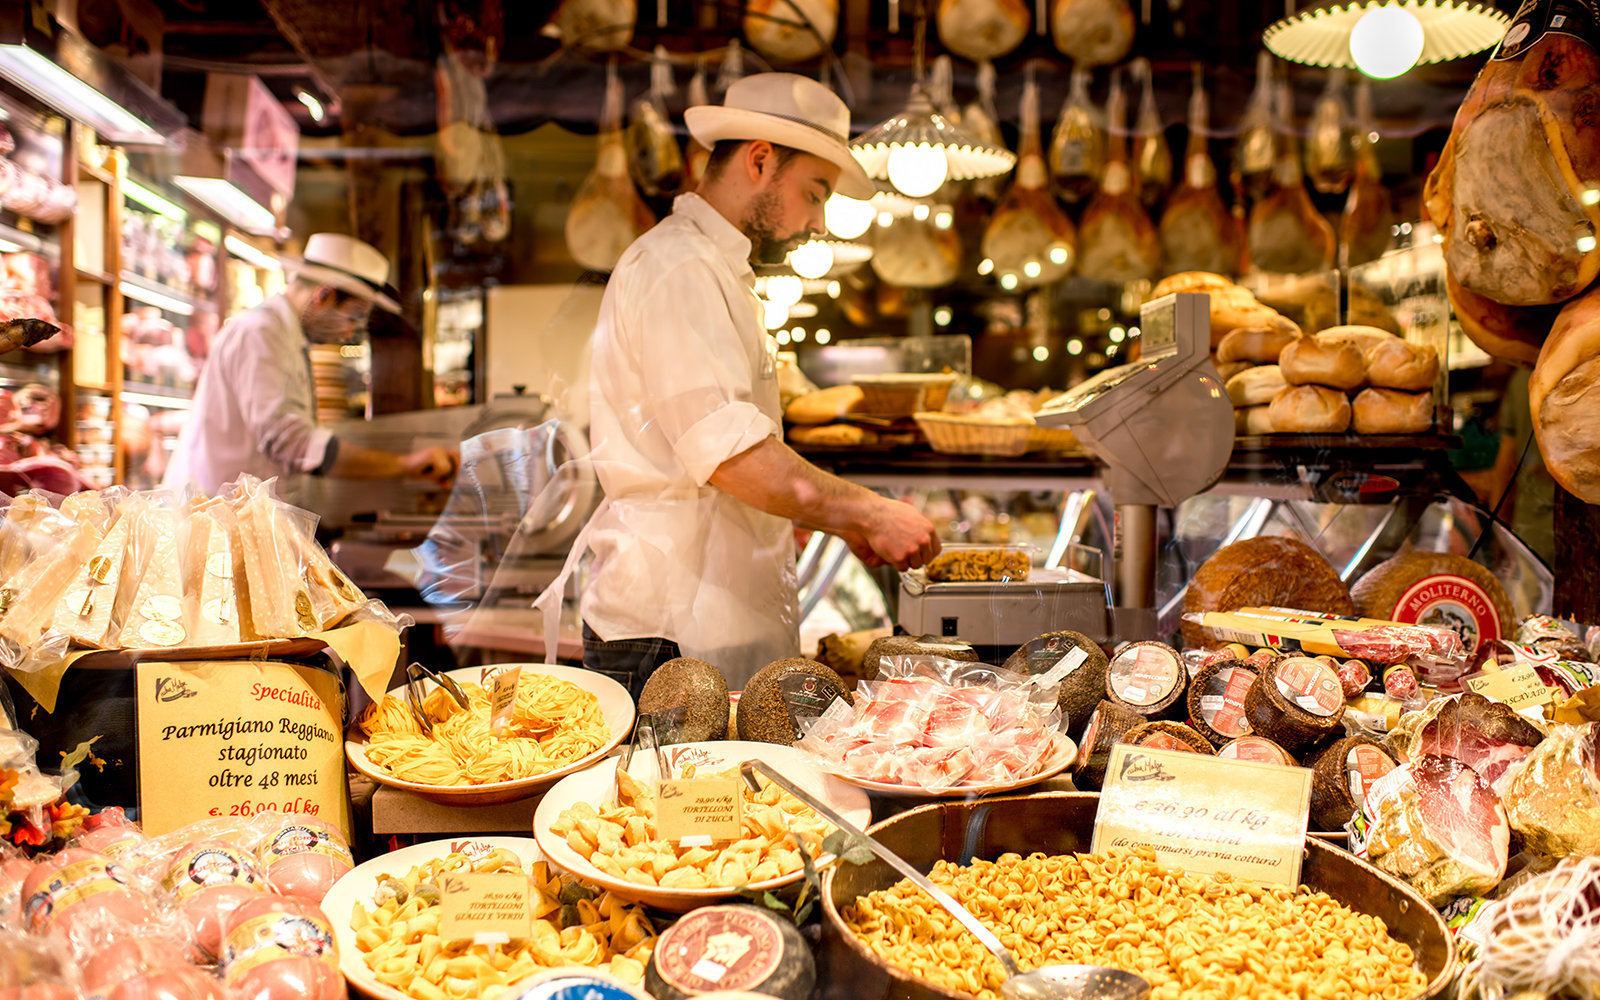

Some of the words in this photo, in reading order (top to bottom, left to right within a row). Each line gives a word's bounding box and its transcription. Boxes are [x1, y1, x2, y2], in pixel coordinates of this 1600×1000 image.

[1409, 584, 1487, 616] MOLITERNO
[250, 682, 321, 710] Specialità
[1509, 688, 1547, 704] SCAVATO
[162, 717, 274, 740] Parmigiano
[278, 717, 335, 743] Reggiano
[218, 743, 307, 766] stagionato
[208, 768, 253, 787] oltre
[258, 771, 279, 789] 48
[284, 770, 318, 786] mesi
[283, 797, 303, 815] al
[303, 799, 320, 817] kg
[682, 805, 734, 814] TORTELLONI
[693, 815, 706, 823] DI
[706, 815, 733, 823] ZUCCA
[1213, 807, 1246, 822] al
[1240, 809, 1271, 831] kg
[1131, 840, 1193, 855] coumarsi
[1190, 847, 1232, 861] previa
[1234, 853, 1282, 868] cottura)
[469, 902, 524, 910] TORTELLONI
[455, 912, 486, 922] GIALLI
[496, 912, 525, 920] VERDI
